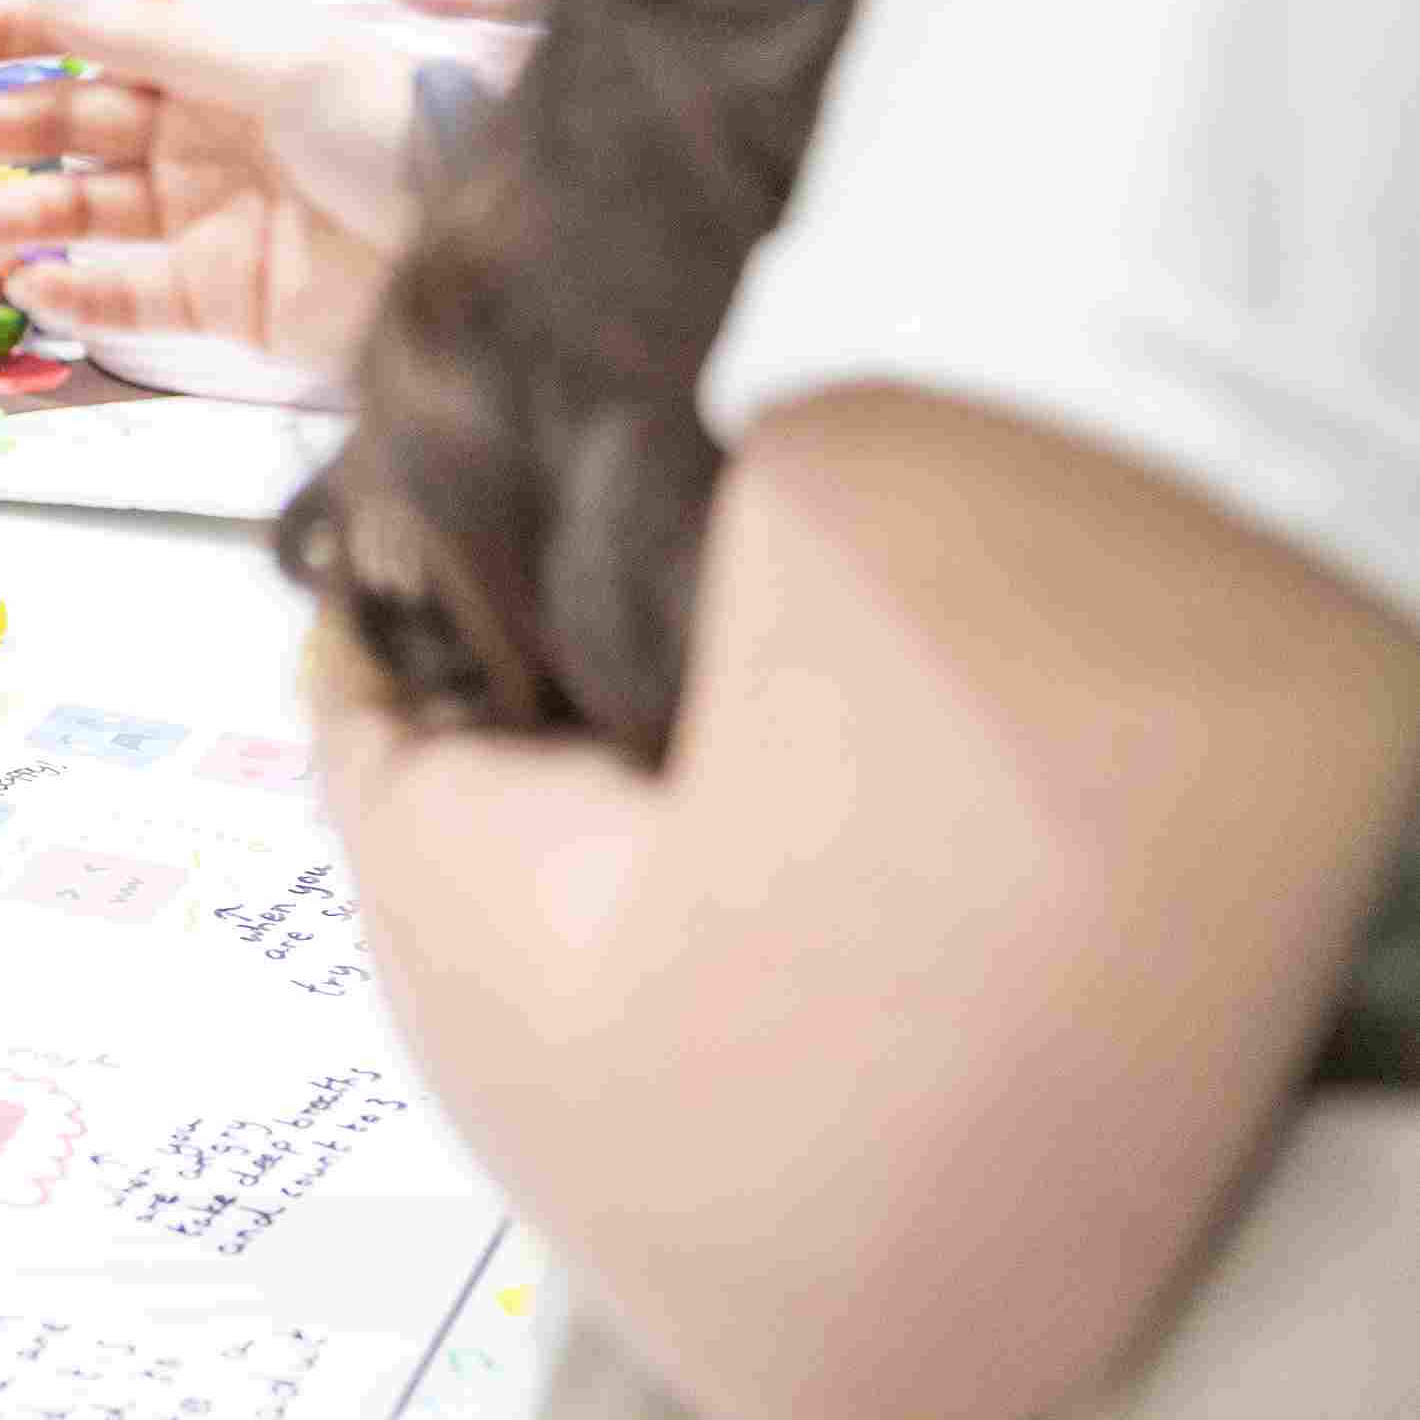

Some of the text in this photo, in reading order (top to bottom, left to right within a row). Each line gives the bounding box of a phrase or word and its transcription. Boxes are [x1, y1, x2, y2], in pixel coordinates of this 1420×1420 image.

[236, 903, 297, 943] when
[287, 864, 335, 899] you
[264, 931, 315, 960] are
